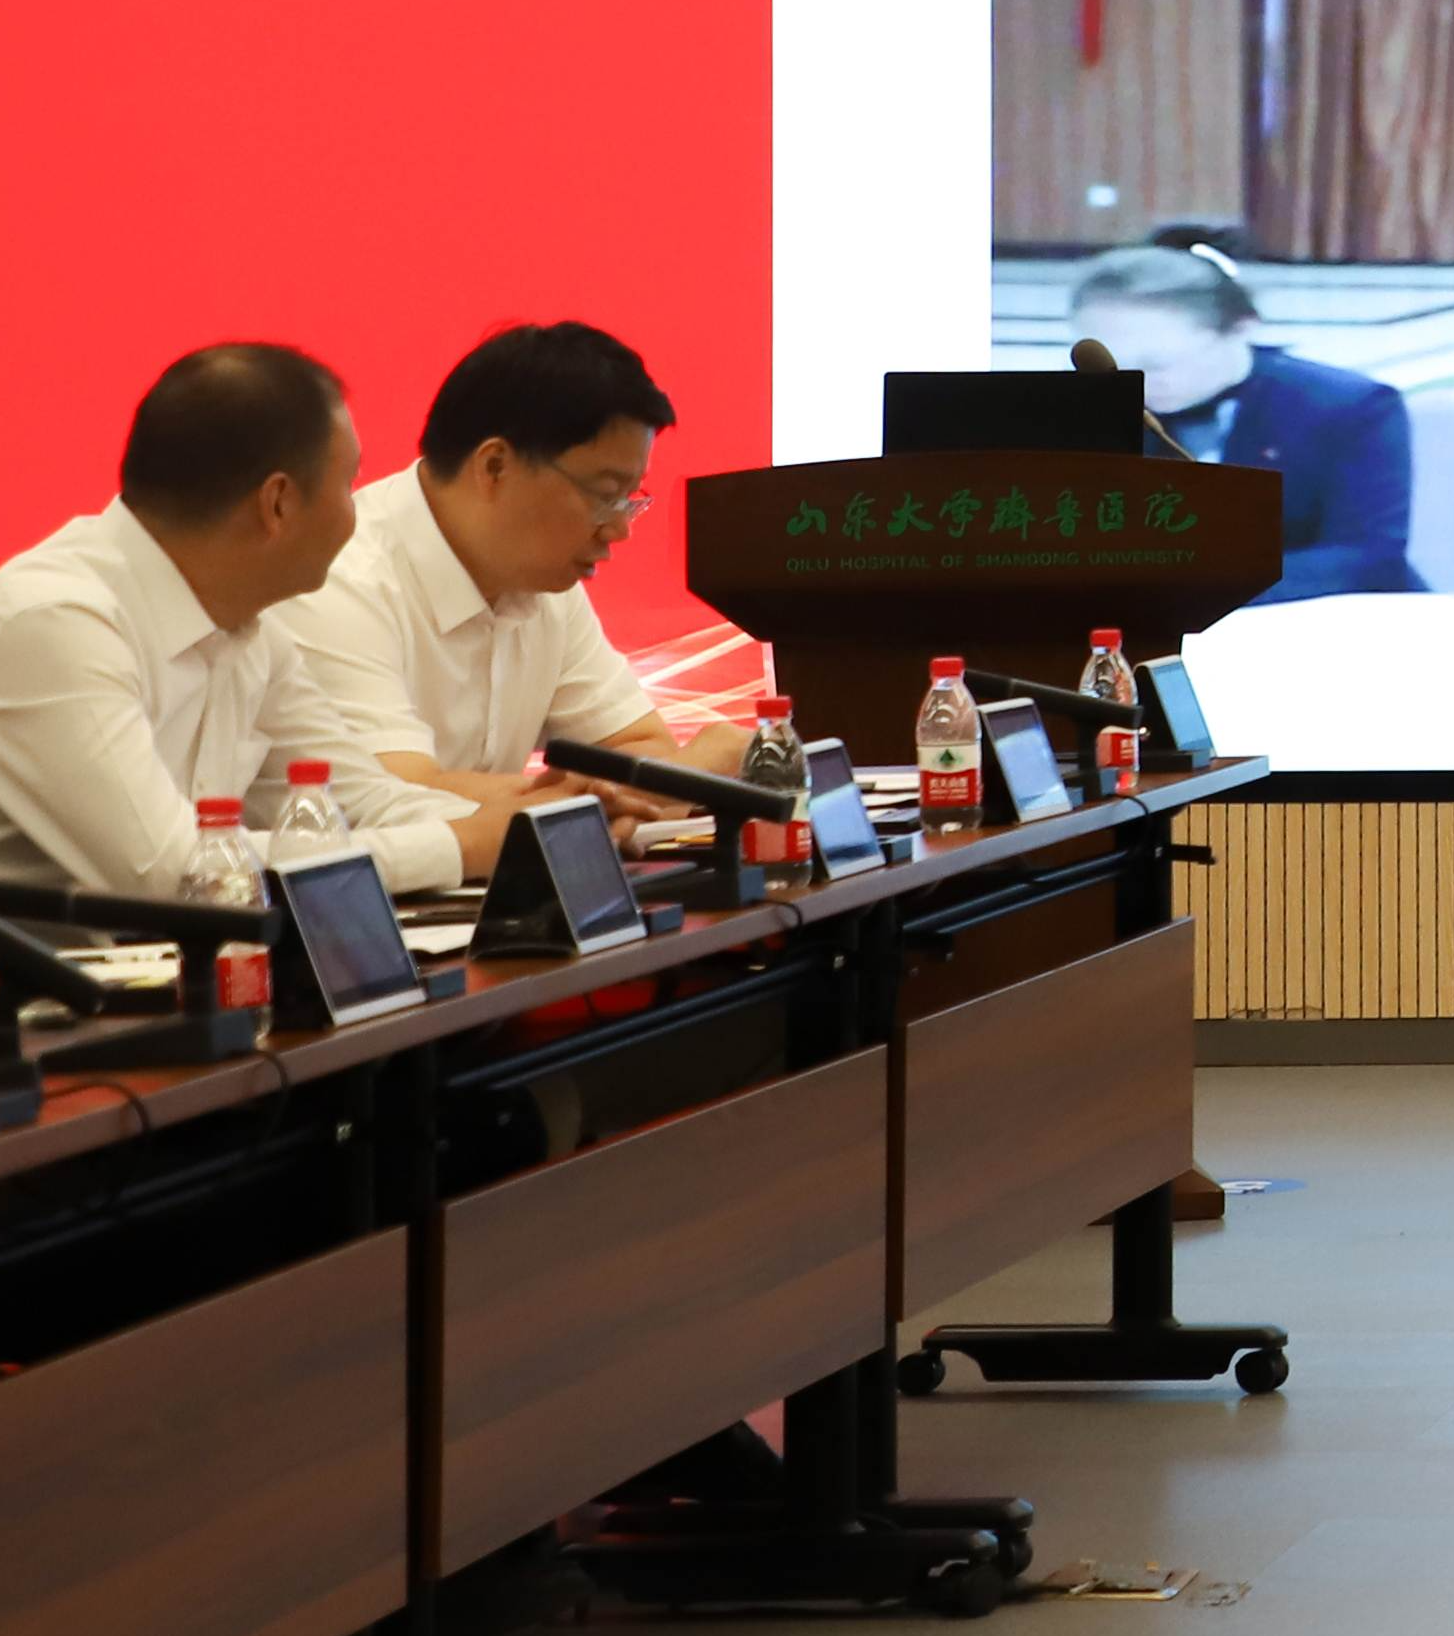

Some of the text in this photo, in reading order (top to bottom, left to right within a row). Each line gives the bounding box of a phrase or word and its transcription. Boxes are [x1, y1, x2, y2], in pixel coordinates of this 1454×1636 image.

[786, 549, 1197, 572] QILU HOSPITAL OF SHANDONG UNIVERSITY
